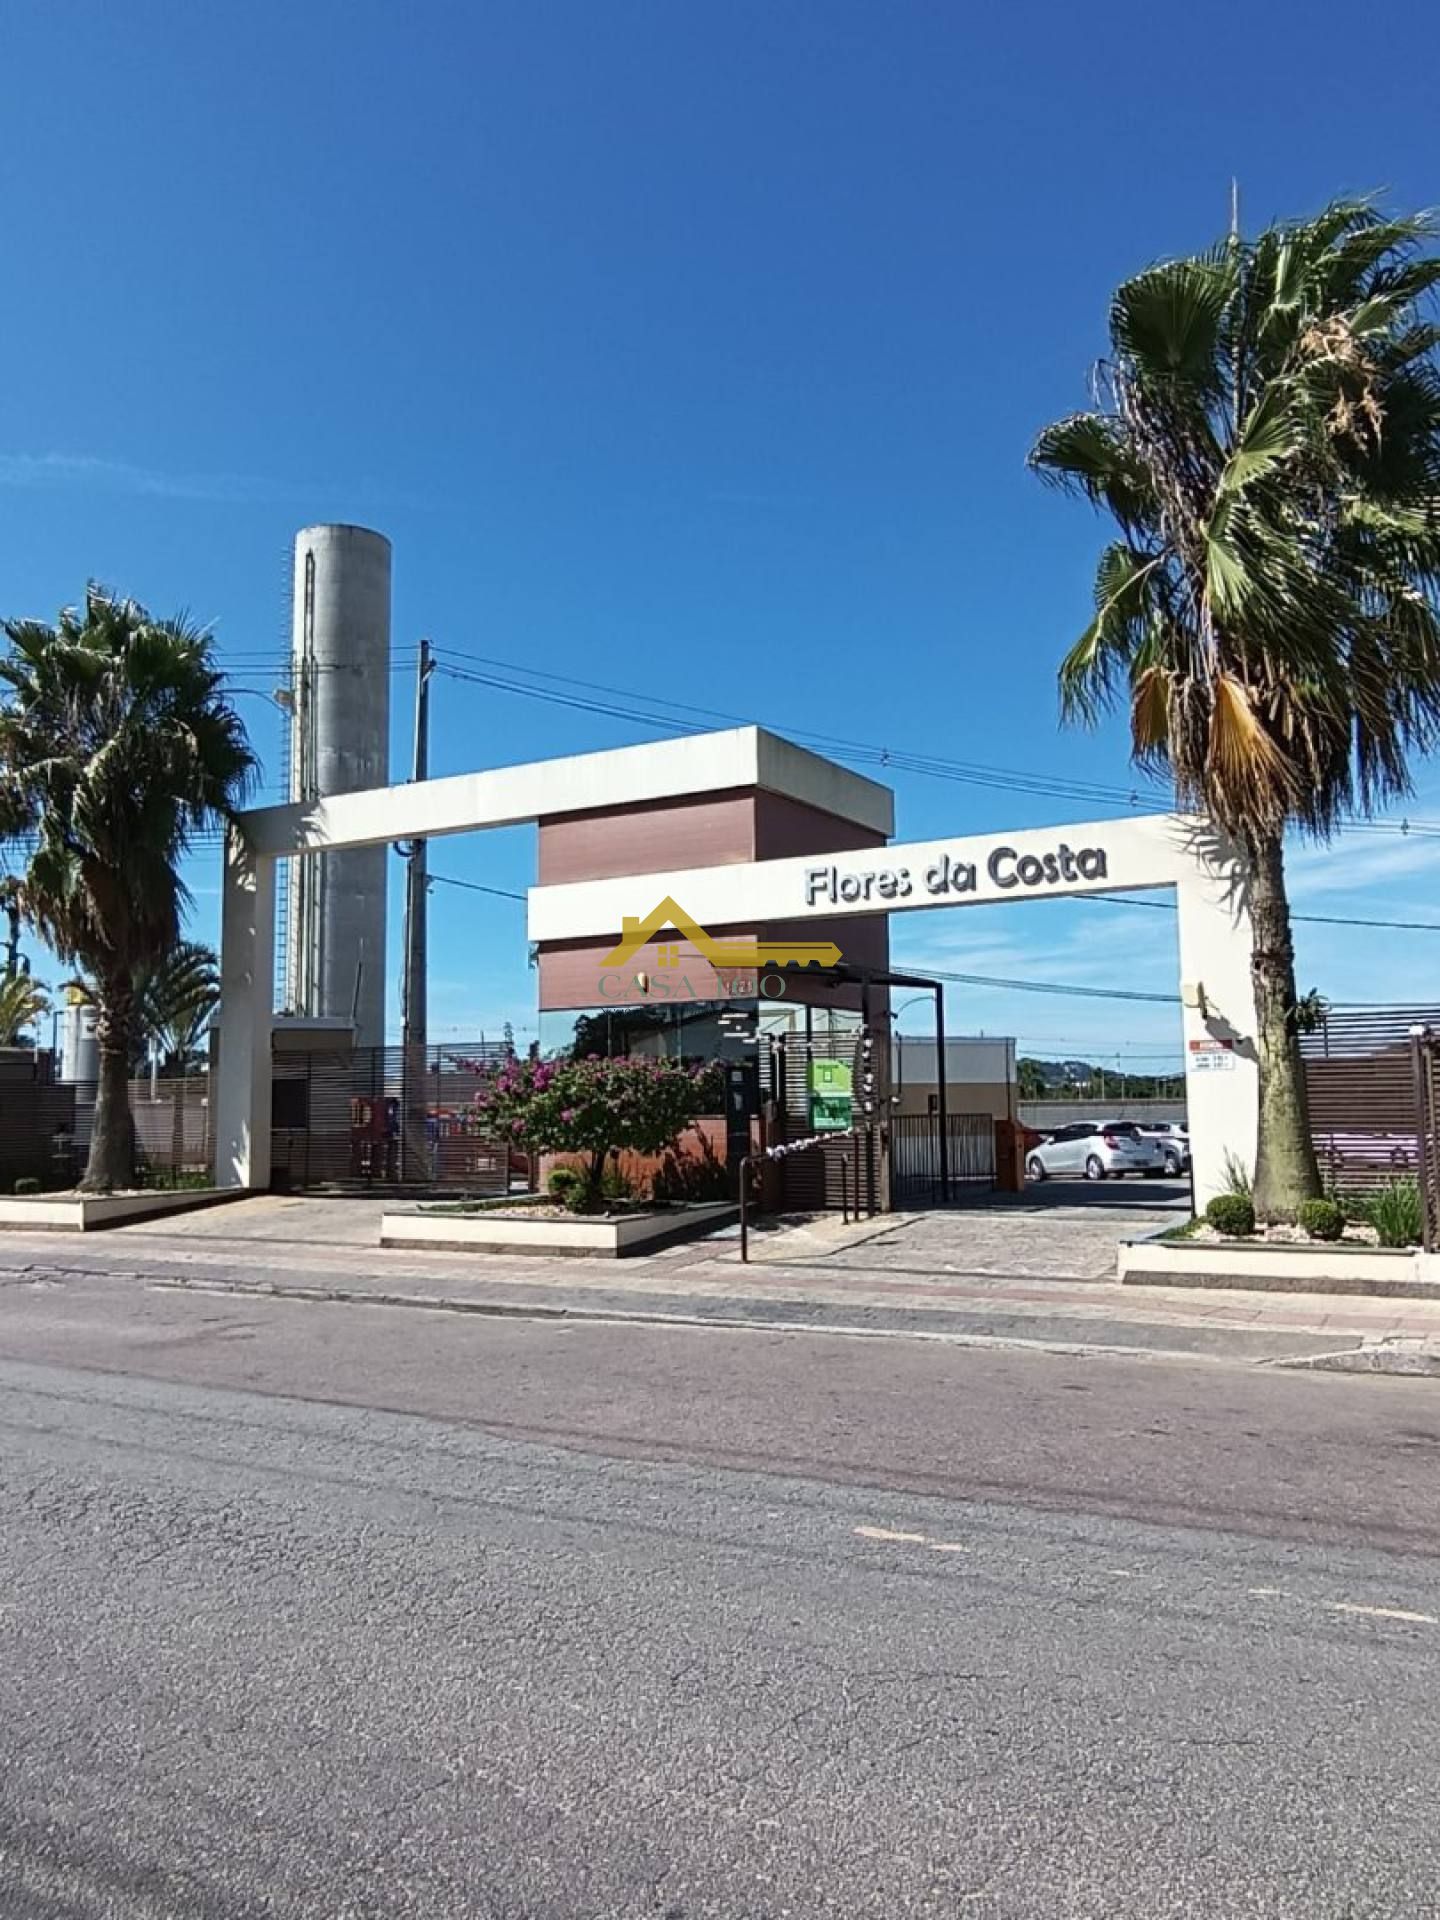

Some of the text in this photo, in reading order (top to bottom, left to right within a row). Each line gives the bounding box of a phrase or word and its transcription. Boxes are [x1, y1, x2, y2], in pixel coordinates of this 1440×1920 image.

[804, 844, 1107, 905] Flores da Costa
